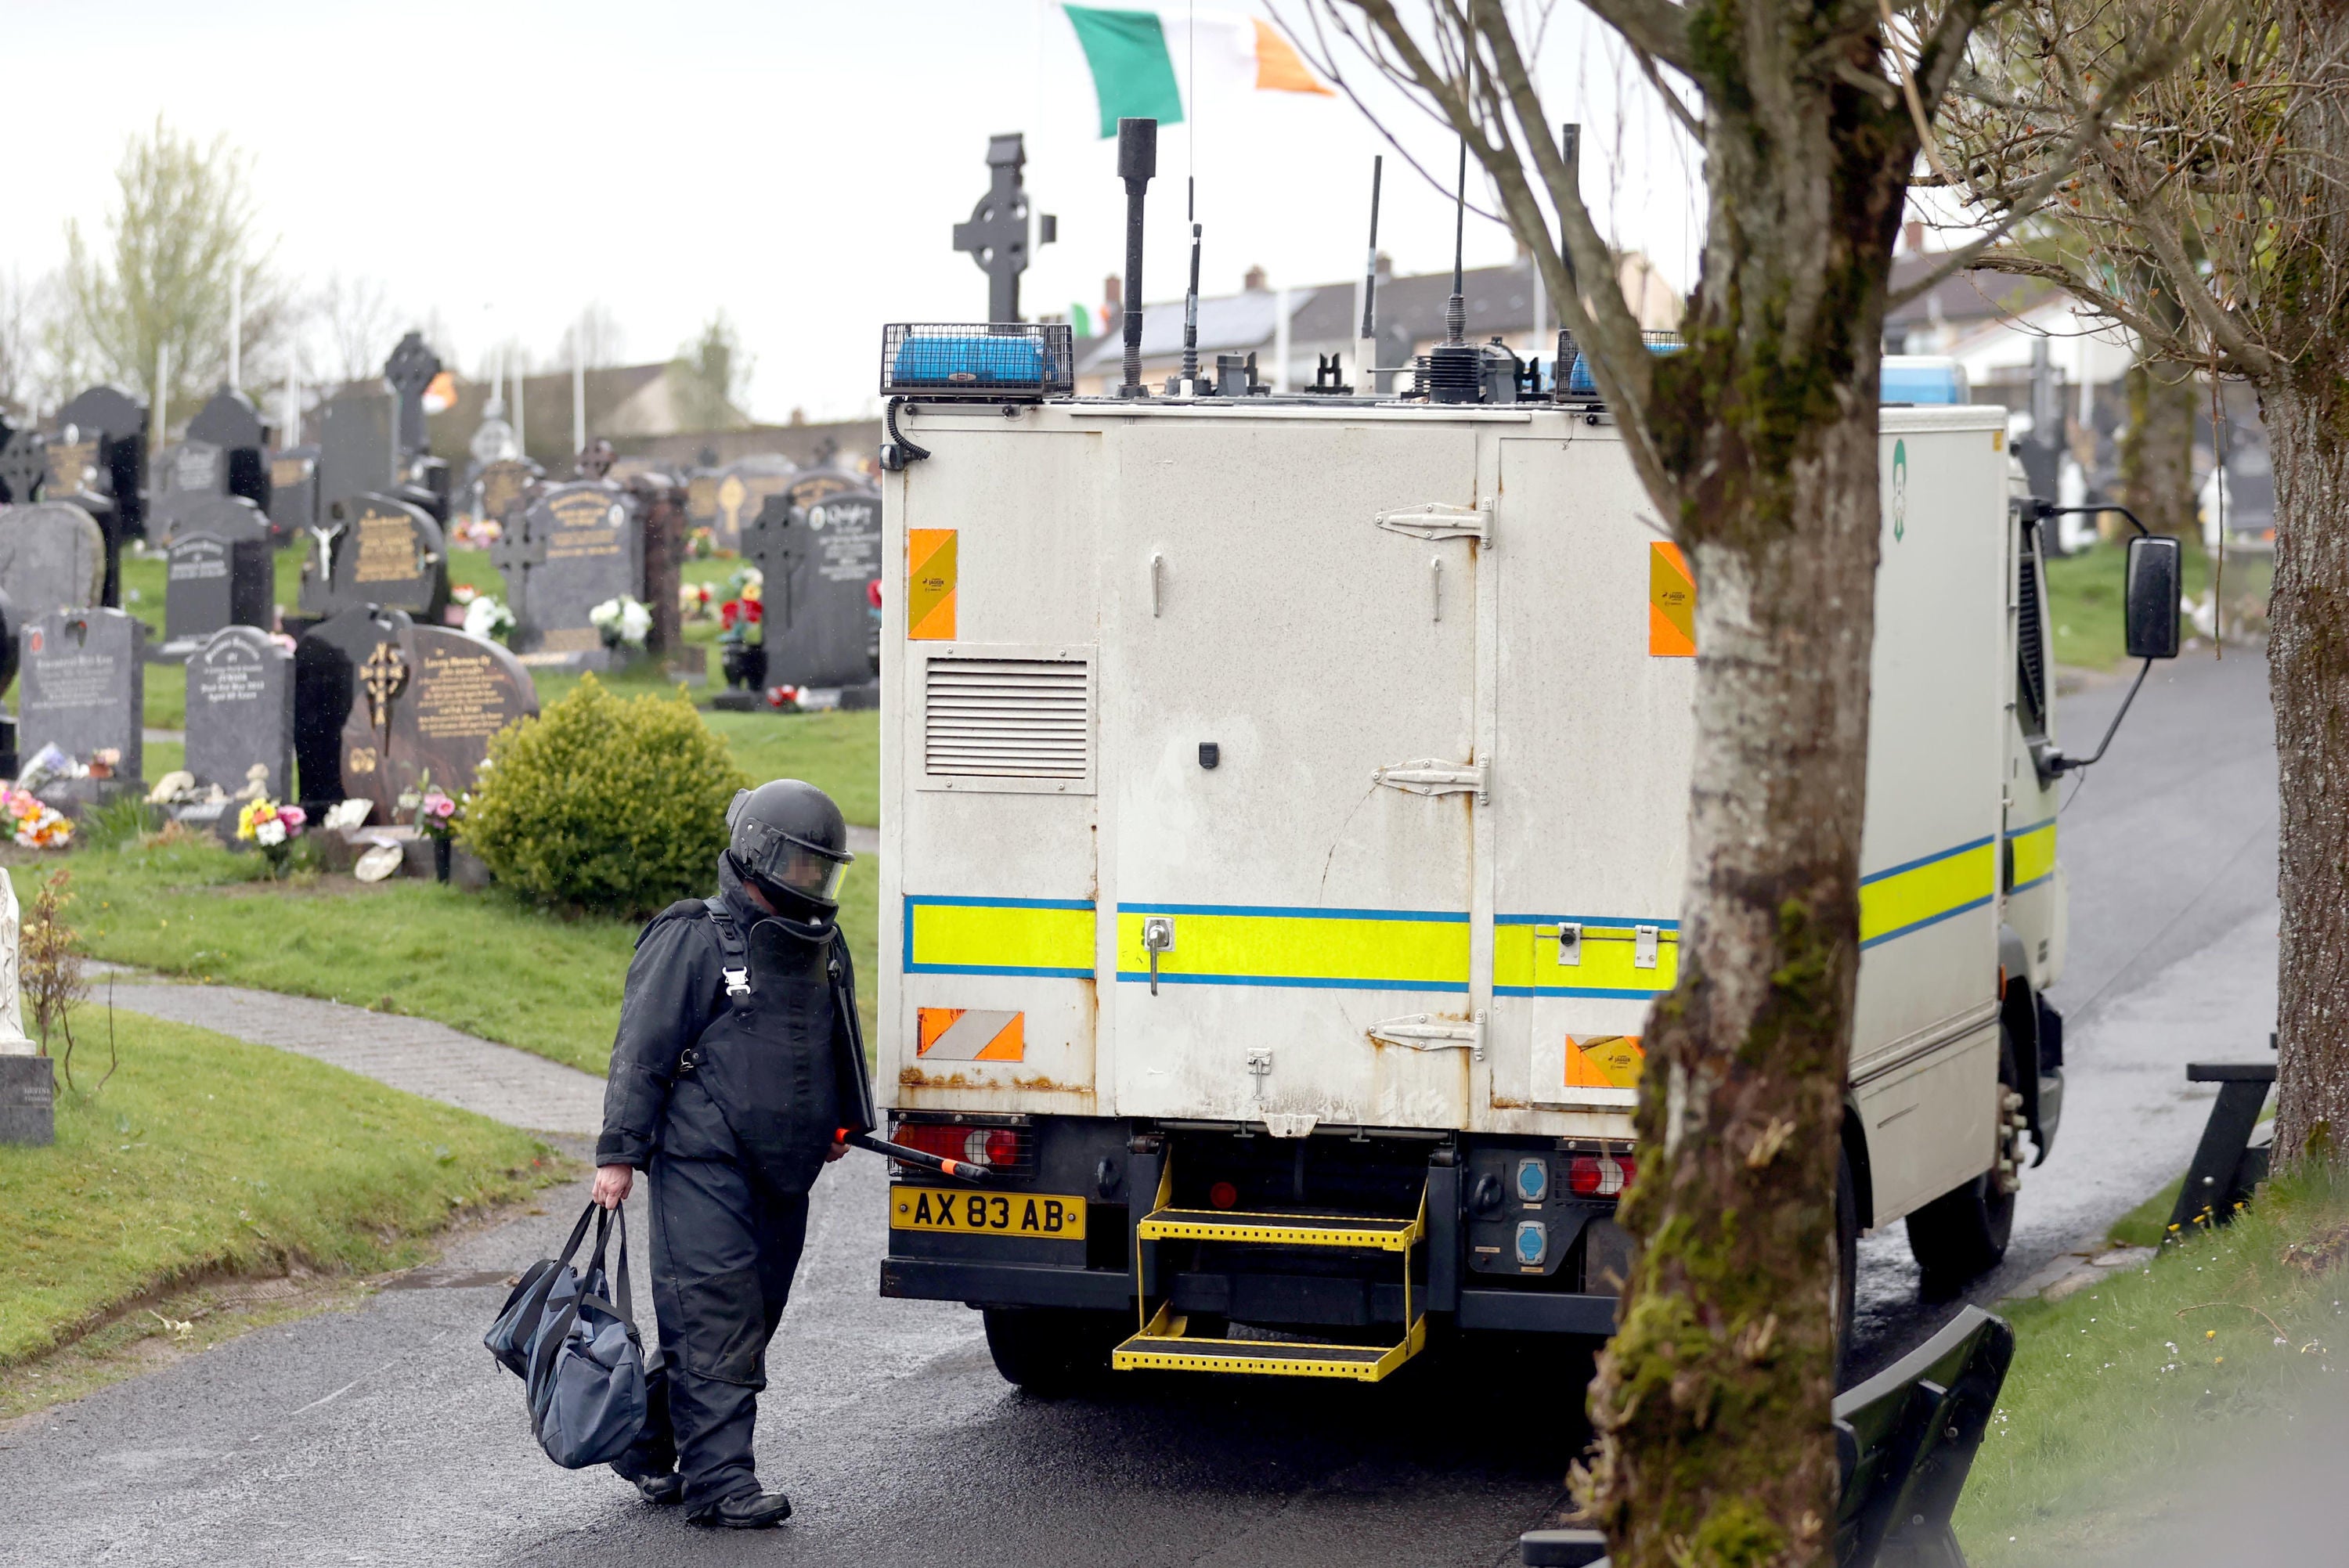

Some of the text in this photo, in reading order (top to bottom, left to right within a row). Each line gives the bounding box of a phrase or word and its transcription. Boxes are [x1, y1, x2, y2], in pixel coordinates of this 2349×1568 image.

[914, 1192, 1063, 1232] AX 83 AB
